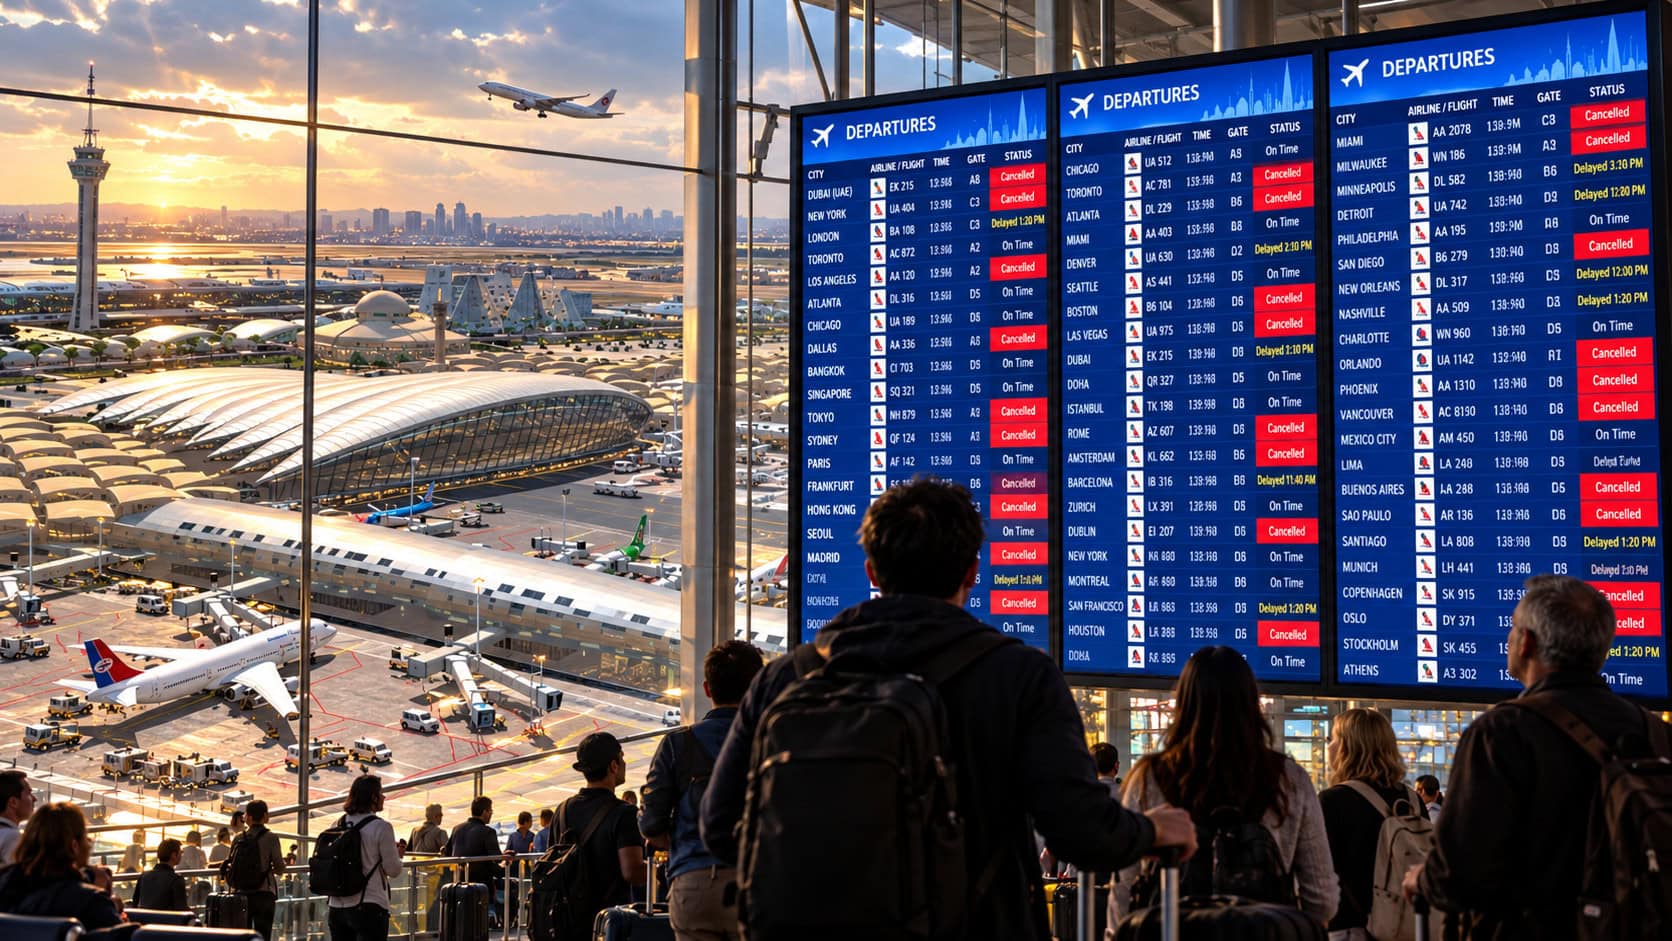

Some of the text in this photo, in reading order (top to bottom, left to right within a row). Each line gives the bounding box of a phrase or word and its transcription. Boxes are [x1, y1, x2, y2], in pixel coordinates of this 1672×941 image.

[1382, 48, 1495, 78] DEPARTURES
[1589, 83, 1625, 97] STATUS
[1104, 84, 1200, 110] DEPARTURES
[1492, 95, 1514, 107] TIME
[1537, 90, 1561, 103] GATE
[1408, 103, 1441, 116] AIRLINE
[1448, 98, 1478, 112] FLIGHT
[1336, 113, 1356, 125] CITY
[1585, 106, 1630, 121] Cancelled
[846, 116, 936, 140] DEPARTURES
[1228, 126, 1248, 138] GATE
[1270, 121, 1301, 134] STATUS
[1433, 123, 1472, 138] AA 2078
[1192, 129, 1211, 140] TIME
[1586, 131, 1630, 146] Cancelled
[1336, 136, 1363, 148] MIAMI
[1066, 143, 1083, 154] CITY
[1265, 144, 1298, 156] On Time
[967, 153, 986, 164] GATE
[1004, 149, 1032, 161] STATUS
[1432, 149, 1466, 162] WN 186
[933, 156, 950, 167] TIME
[1145, 155, 1172, 168] UA 512
[1336, 157, 1387, 172] MILWAUKEE
[808, 169, 824, 180] CITY
[1000, 168, 1035, 182] Cancelled
[1066, 162, 1099, 176] CHICAGO
[1264, 167, 1301, 180] Cancelled
[889, 180, 914, 192] EK 215
[1145, 179, 1171, 191] AC 781
[1434, 174, 1466, 187] DL 582
[832, 186, 853, 200] (UAE)
[1066, 186, 1102, 199] TORONTO
[1337, 180, 1396, 196] MINNEAPOLIS
[1434, 199, 1467, 212] UA 742
[808, 209, 846, 222] NEW YORK
[1066, 210, 1100, 222] ATLANTA
[1337, 207, 1374, 221] DETROIT
[1589, 213, 1630, 226] On Time
[1434, 224, 1466, 237] AA 195
[808, 231, 840, 243] LONDON
[1338, 230, 1399, 245] PHILADELPHIA
[1002, 240, 1033, 251] On Time
[808, 252, 844, 265] TORONTO
[1435, 250, 1468, 263] B6 279
[1001, 261, 1035, 274] Cancelled
[1066, 257, 1096, 270] DENVER
[1338, 256, 1384, 270] SAN DIEGO
[1576, 264, 1648, 281] Delayed 12:00 PM
[808, 274, 857, 287] LOS ANGELES
[1146, 276, 1172, 287] AS 441
[1436, 275, 1468, 288] DL 317
[1066, 281, 1098, 294] SEATTLE
[1338, 280, 1400, 295] NEW ORLEANS
[808, 297, 842, 309] ATLANTA
[1266, 291, 1303, 304] Cancelled
[1067, 305, 1098, 317] BOSTON
[1339, 306, 1385, 320] NASHVILLE
[807, 320, 841, 332] CHICAGO
[1067, 328, 1108, 341] LAS VEGAS
[1339, 332, 1390, 345] CHARLOTTE
[808, 342, 837, 354] DALLAS
[1067, 354, 1091, 366] DUBAI
[1339, 357, 1382, 370] ORLANDO
[808, 366, 845, 377] BANGKOK
[890, 362, 914, 373] CI 703
[1002, 382, 1034, 392] On Time
[1067, 379, 1090, 390] DOHA
[1340, 383, 1378, 395] PHOENIX
[808, 388, 852, 400] SINGAPORE
[890, 386, 914, 398] SQ 321
[1593, 400, 1638, 413] Cancelled
[808, 412, 834, 423] TOKYO
[1340, 408, 1394, 420] VANCOUVER
[1068, 428, 1090, 439] ROME
[1341, 433, 1396, 445] MEXICO CITY
[807, 435, 838, 446] SYDNEY
[1068, 452, 1115, 463] AMSTERDAM
[1268, 448, 1304, 459] Cancelled
[808, 458, 831, 468] PARIS
[1341, 460, 1363, 471] LIMA
[808, 480, 854, 492] FRANKFURT
[1001, 478, 1036, 488] Cancelled
[1068, 477, 1113, 488] BARCELONA
[1342, 484, 1405, 496] BUENOS AIRES
[807, 504, 856, 516] HONG KONG
[1001, 502, 1036, 512] Cancelled
[1068, 502, 1096, 512] ZURICH
[1342, 510, 1392, 521] SAO PAULO
[1596, 508, 1641, 520] Cancelled
[807, 528, 834, 539] SEOUL
[1342, 536, 1387, 547] SANTIAGO
[1584, 536, 1656, 550] Delayed 1:20 PM
[807, 552, 840, 563] MADRID
[1068, 550, 1108, 561] NEW YORK
[1270, 551, 1304, 562] On Time
[1342, 561, 1378, 573] MUNICH
[1068, 575, 1110, 586] MONTREAL
[1342, 586, 1403, 599] COPENHAGEN
[1442, 588, 1475, 600] SK 915
[1068, 600, 1083, 611] SAN
[1343, 612, 1367, 624] OSLO
[1442, 614, 1475, 626] DY 371
[1068, 625, 1105, 636] HOUSTON
[1270, 628, 1307, 640] Cancelled
[1344, 638, 1398, 650] STOCKHOLM
[1344, 664, 1379, 676] ATHENS
[1443, 668, 1477, 680] A3 302
